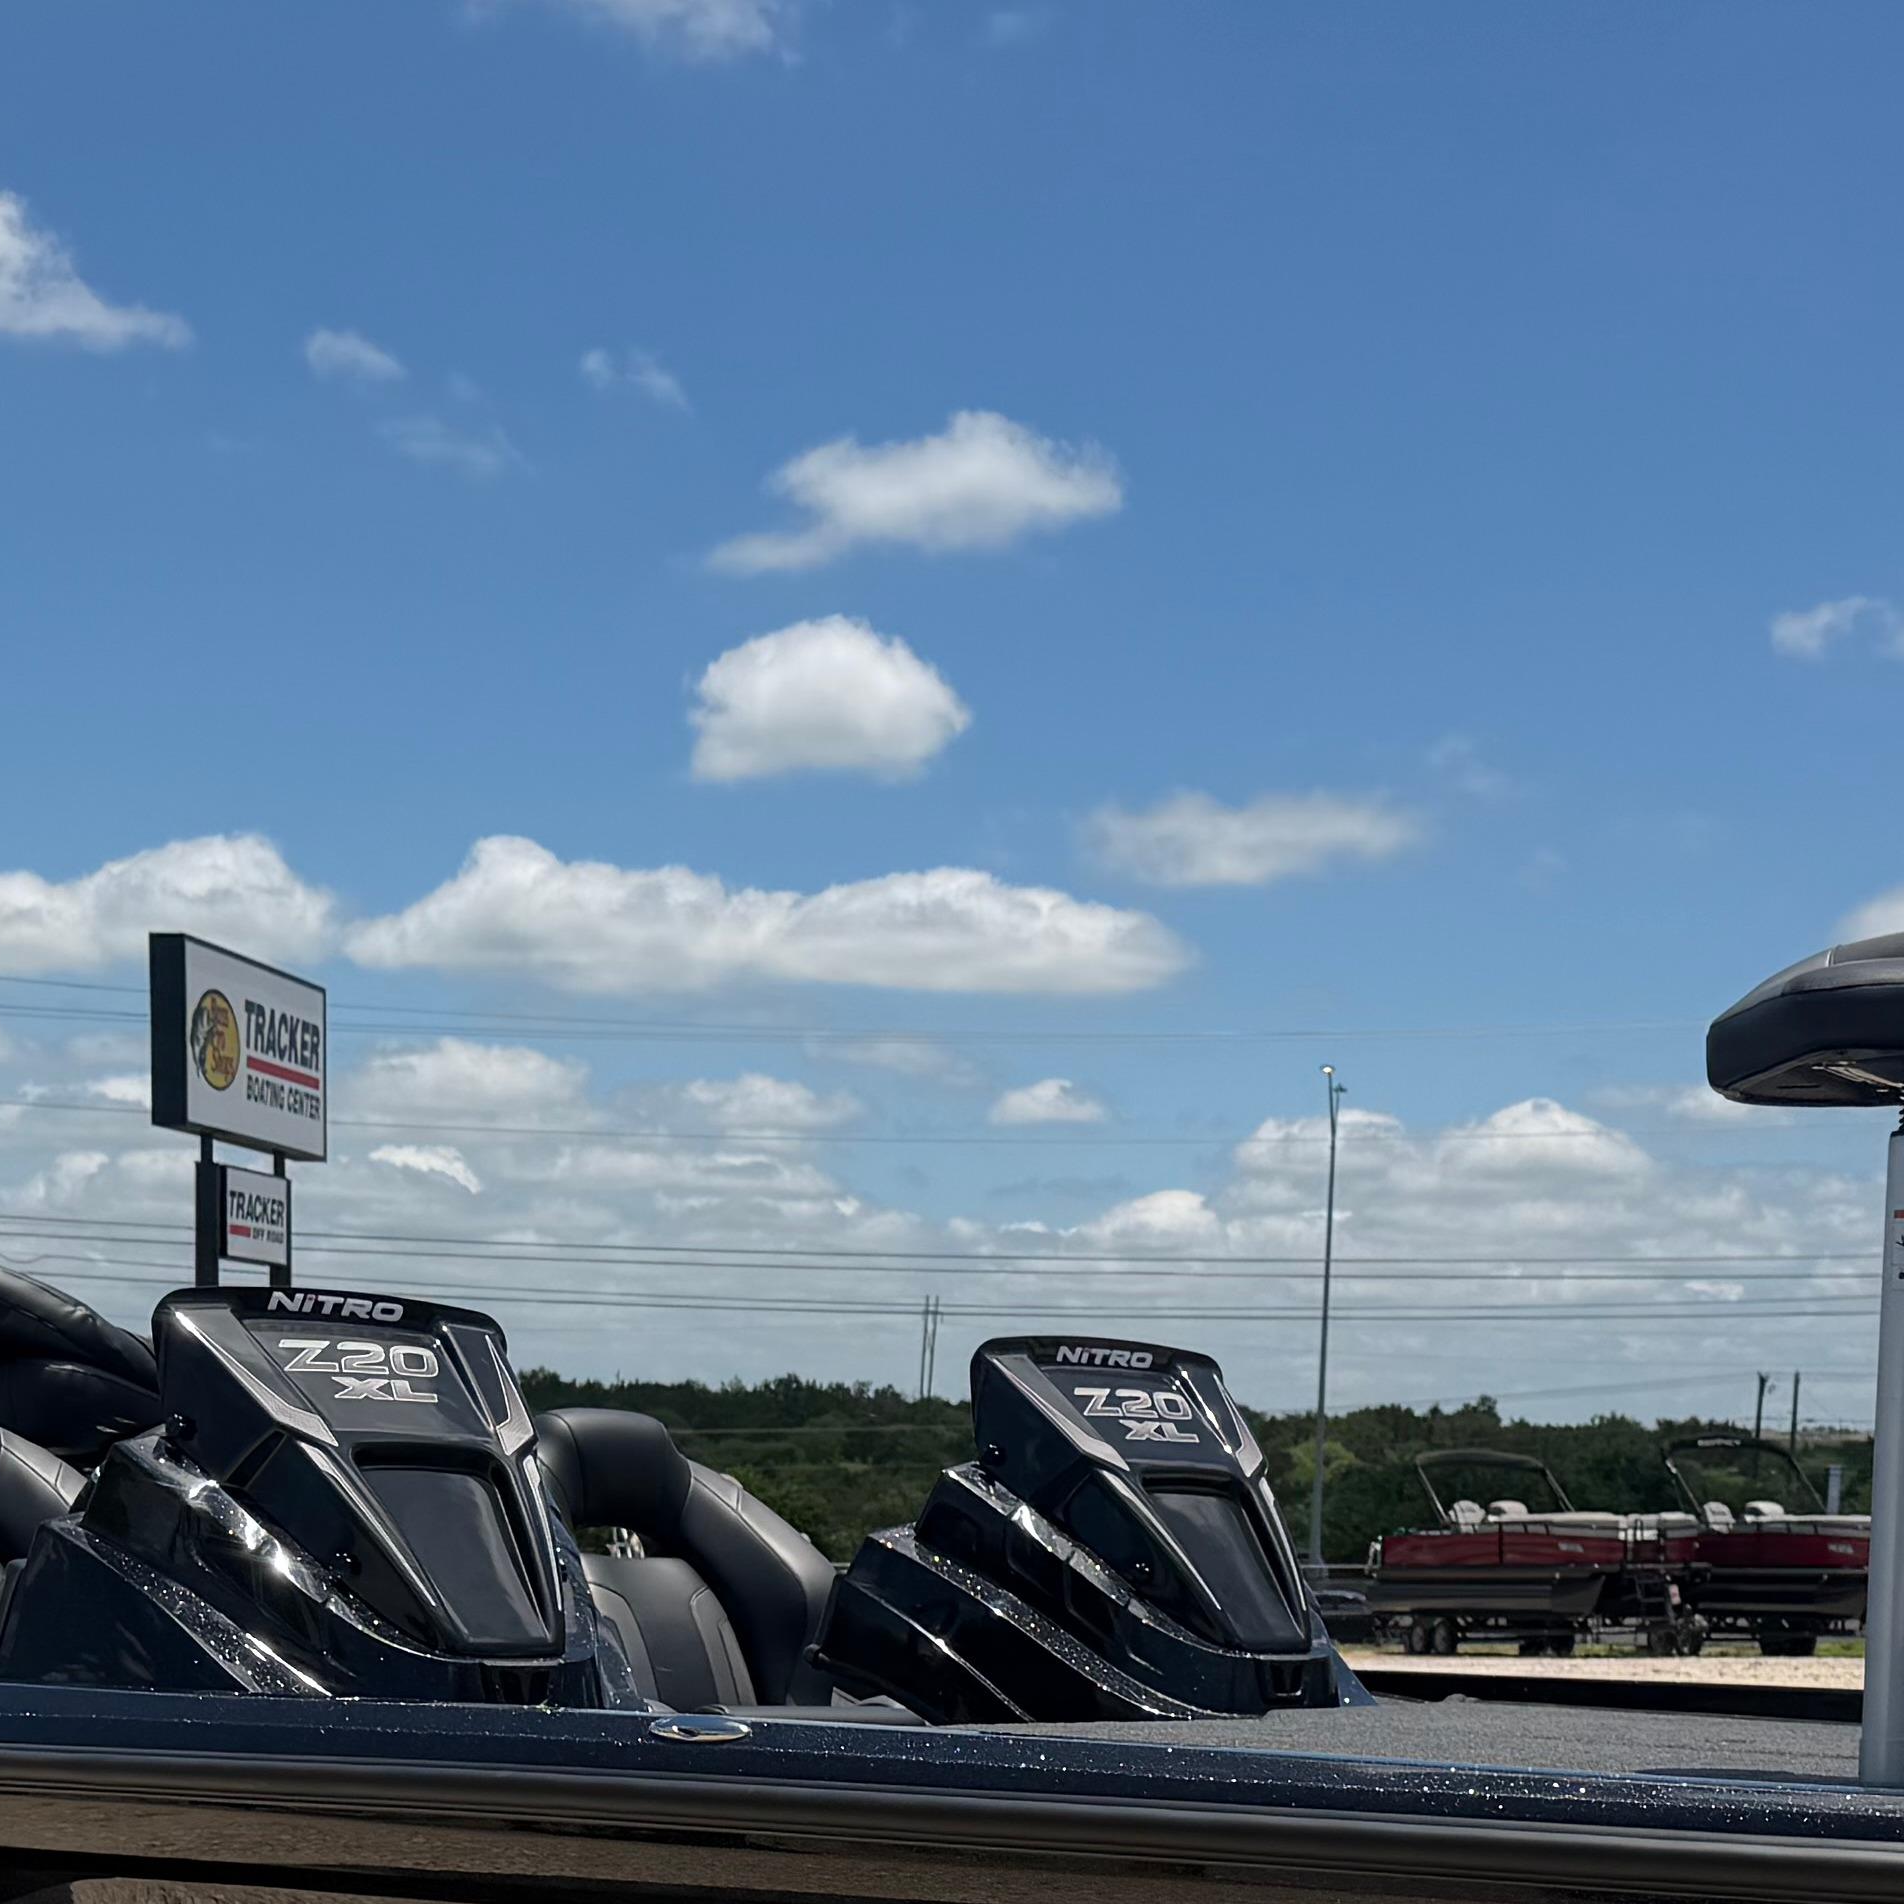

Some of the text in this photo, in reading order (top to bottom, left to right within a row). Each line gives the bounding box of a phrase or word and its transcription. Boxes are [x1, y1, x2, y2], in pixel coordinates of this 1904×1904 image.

[244, 999, 320, 1073] TRACKER
[246, 1074, 321, 1121] BOATING CENTER
[229, 1190, 285, 1228] TRACKER
[278, 1338, 439, 1377] Z20
[331, 1376, 439, 1403] XL
[1073, 1386, 1193, 1420] Z20
[1118, 1418, 1201, 1443] XL
